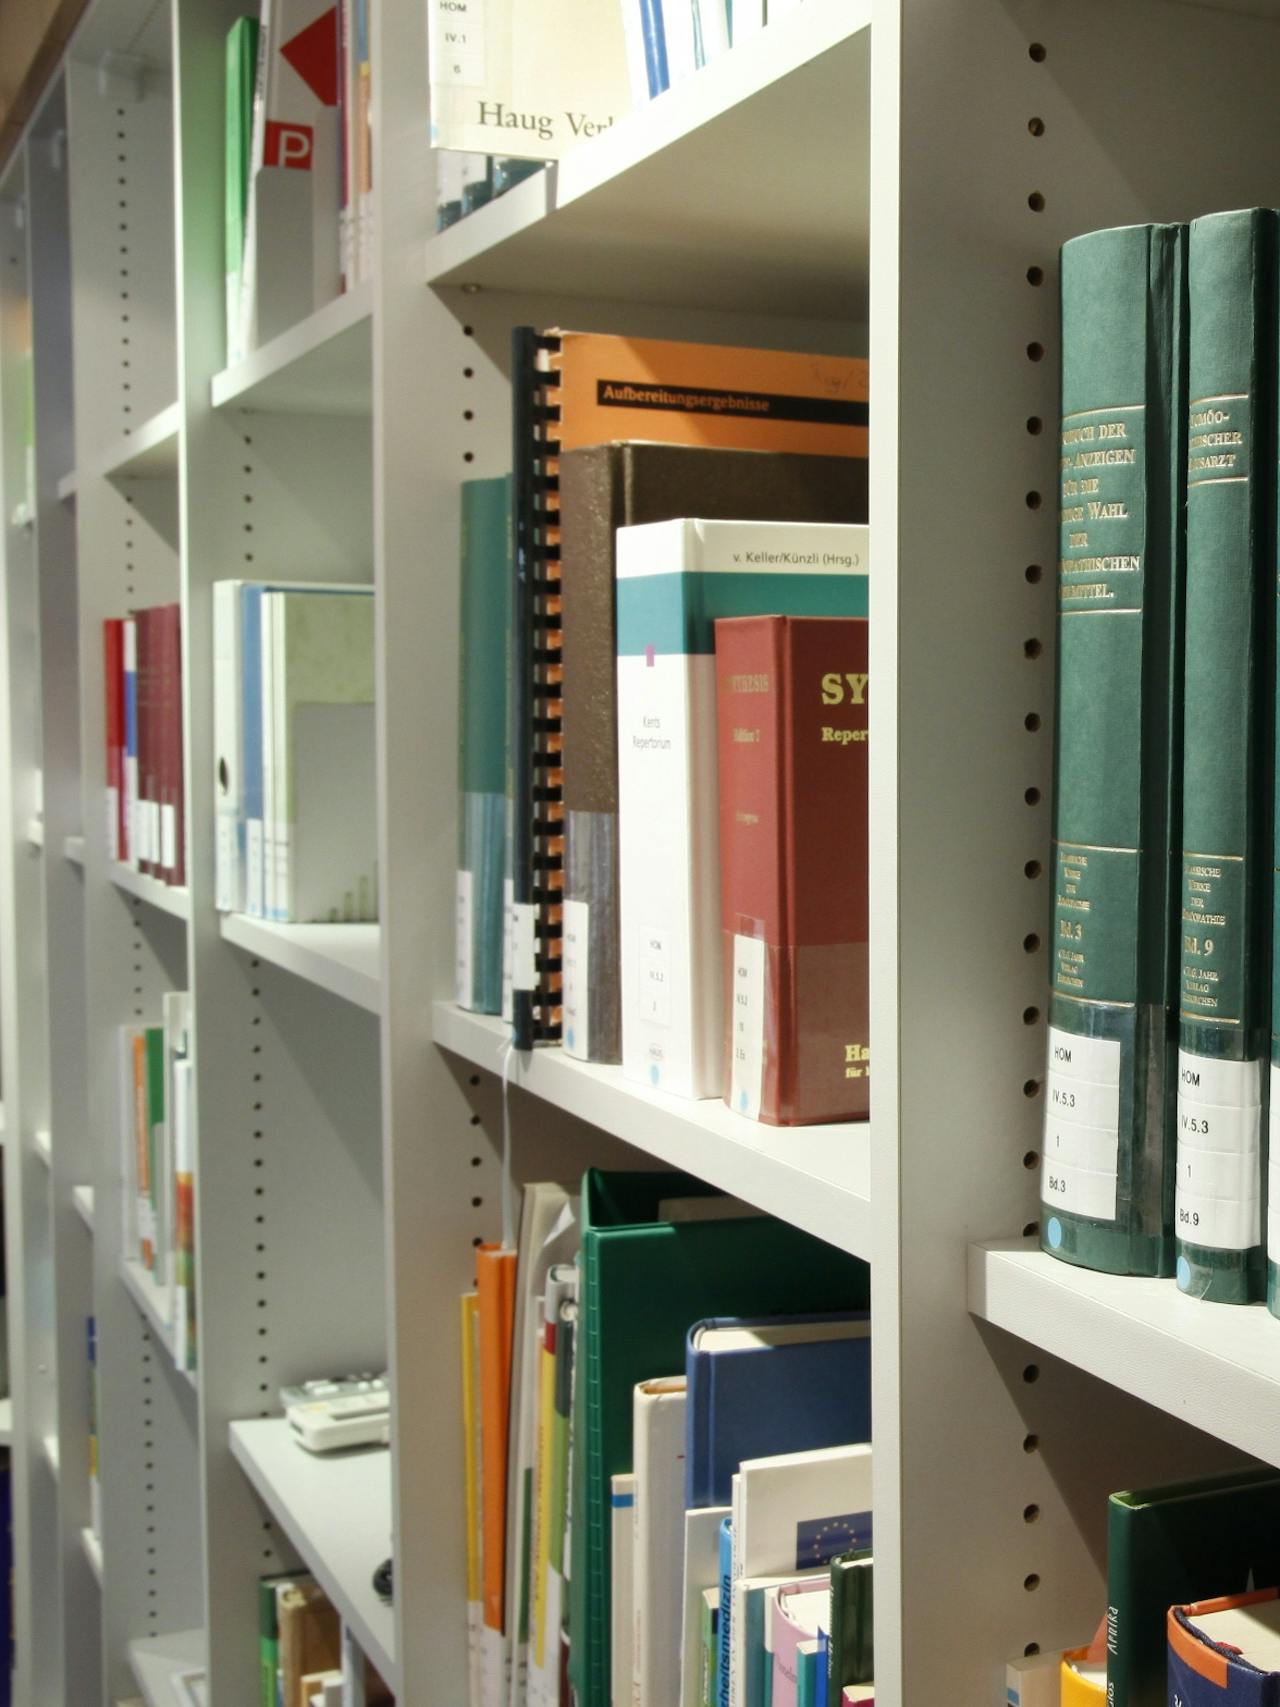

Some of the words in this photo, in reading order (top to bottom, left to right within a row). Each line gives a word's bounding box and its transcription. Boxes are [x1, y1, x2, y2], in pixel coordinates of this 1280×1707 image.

[440, 1, 467, 13] HOM
[478, 101, 553, 140] Haug
[280, 131, 309, 168] P
[603, 385, 769, 411] Aufbereitungsergebnisse
[1099, 423, 1127, 440] DER
[746, 552, 819, 564] Keller/Künzli
[823, 553, 859, 567] (Hrsg.)
[633, 735, 671, 750] Repertorium
[1203, 939, 1214, 956] 9
[1055, 1046, 1071, 1063] HOM
[1182, 1069, 1200, 1087] HOM
[1052, 1092, 1075, 1108] IV.5.3
[1182, 1116, 1209, 1134] IV.5.3
[1188, 1164, 1192, 1178] 1
[1049, 1176, 1066, 1193] Bd.3
[1180, 1208, 1199, 1226] Bd.9
[1109, 1606, 1119, 1655] Arnika
